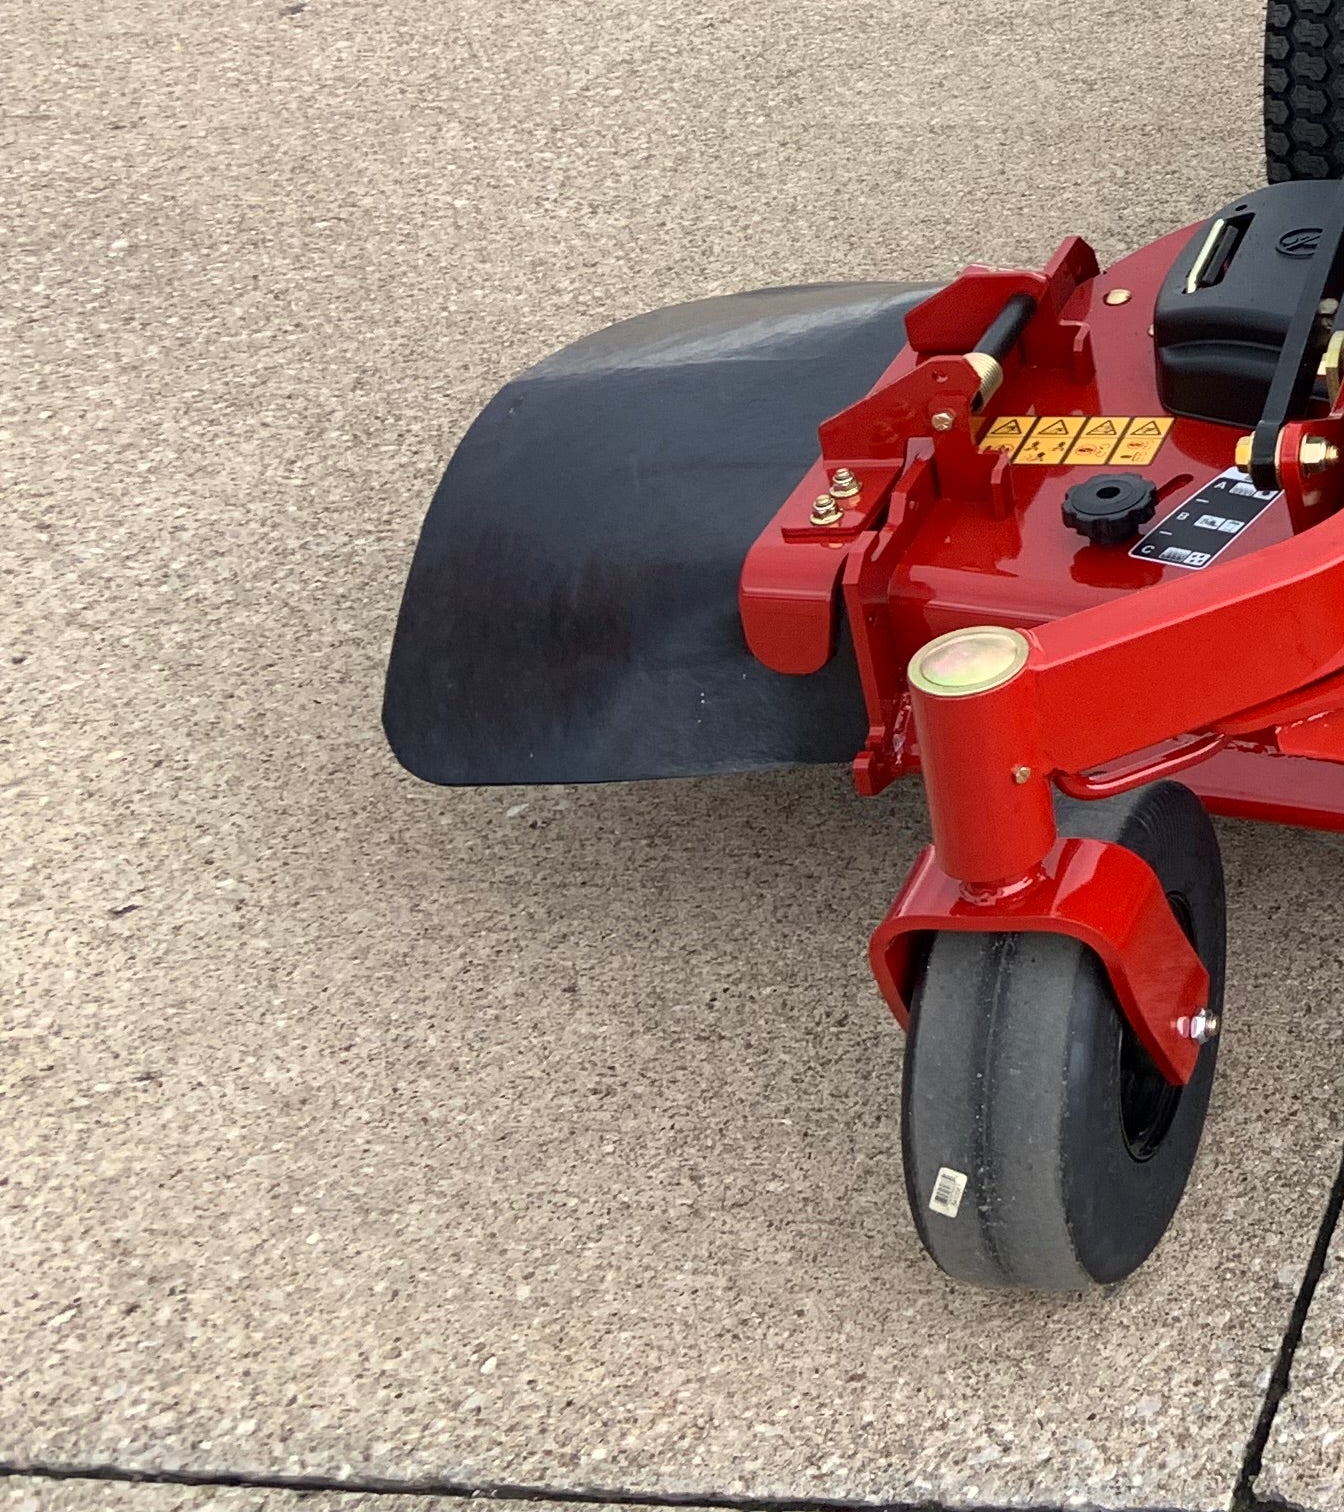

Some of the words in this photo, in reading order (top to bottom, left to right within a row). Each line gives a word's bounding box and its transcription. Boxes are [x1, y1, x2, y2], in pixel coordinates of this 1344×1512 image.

[1213, 481, 1228, 490] A
[1176, 511, 1190, 521] B
[1140, 545, 1155, 554] C
